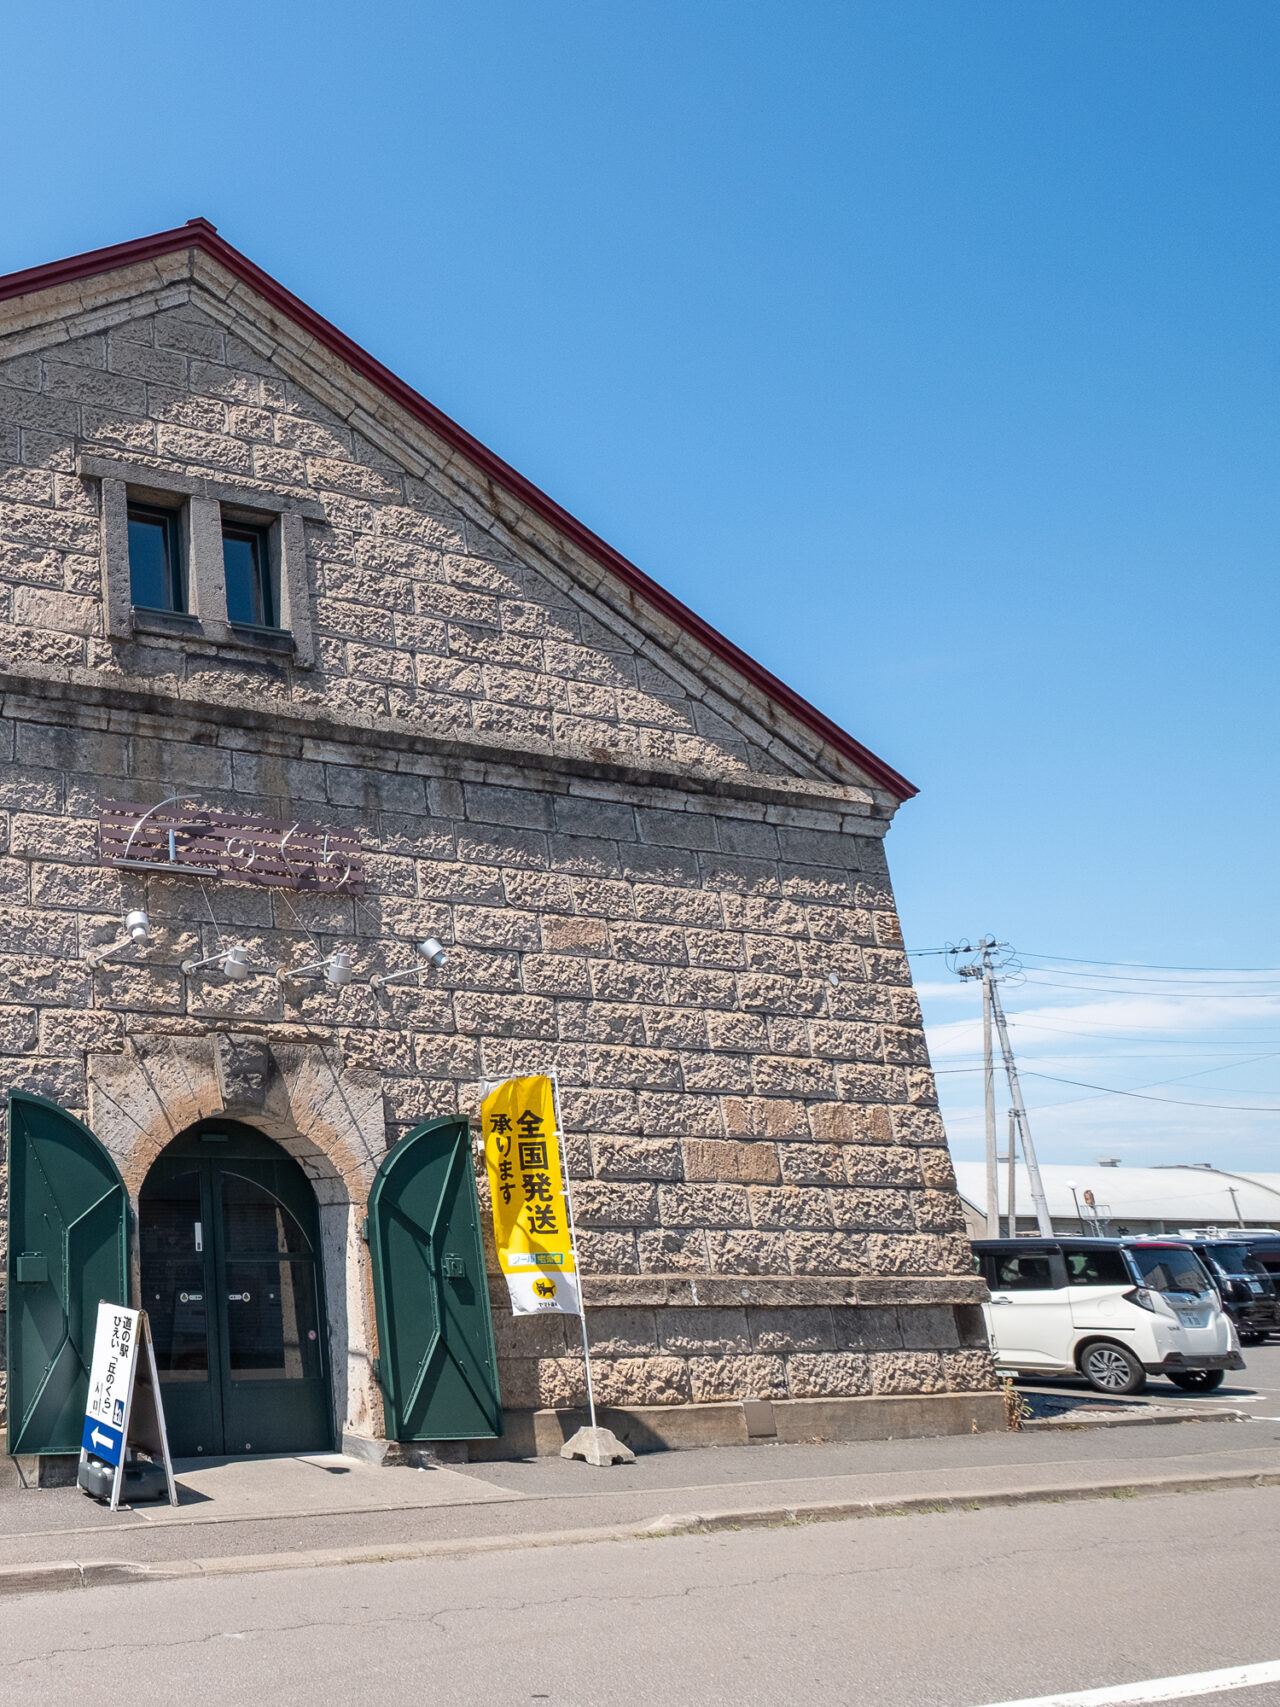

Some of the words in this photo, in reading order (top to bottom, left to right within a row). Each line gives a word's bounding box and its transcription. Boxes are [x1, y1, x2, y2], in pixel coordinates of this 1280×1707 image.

[489, 1113, 516, 1205] 承ります
[516, 1110, 559, 1234] 全国発送
[119, 1315, 132, 1358] 道の駅
